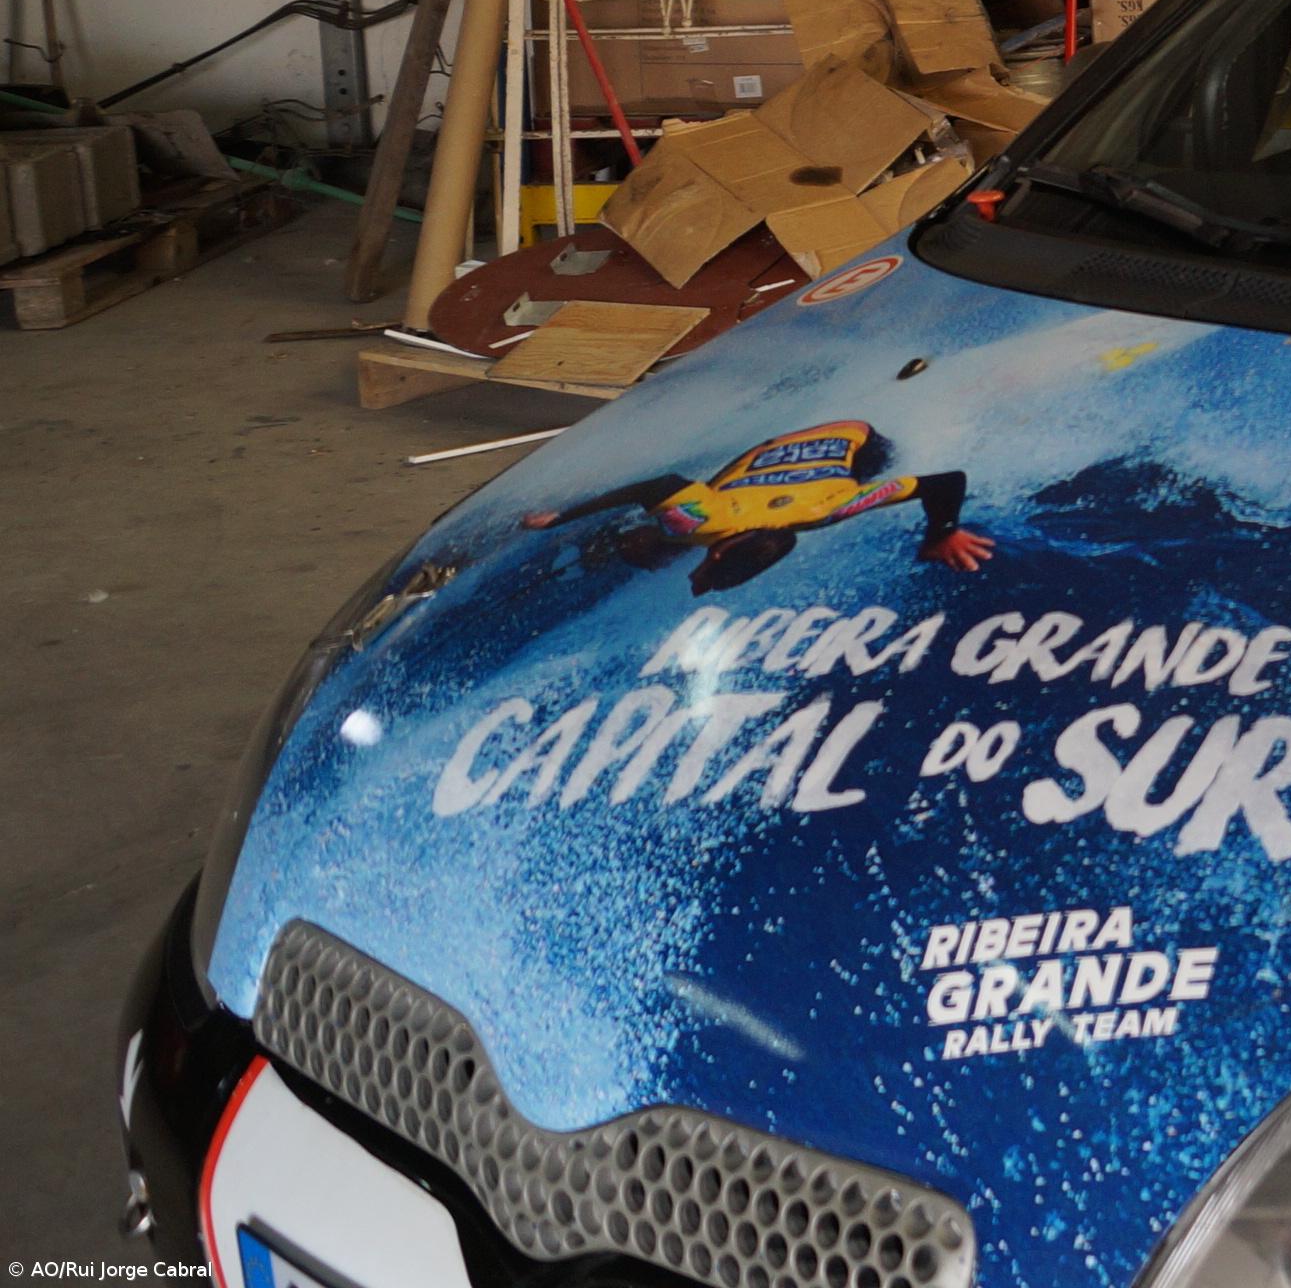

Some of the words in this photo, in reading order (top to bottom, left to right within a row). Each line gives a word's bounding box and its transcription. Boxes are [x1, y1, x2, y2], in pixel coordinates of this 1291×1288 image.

[638, 605, 946, 678] RIBEIRA
[430, 687, 886, 820] CAPITAL
[918, 718, 1022, 783] DO
[921, 906, 1135, 970] RIBEIRA
[926, 945, 1218, 1029] GRANDE
[942, 1016, 1057, 1062] RALLY
[1071, 1004, 1181, 1045] TEAM
